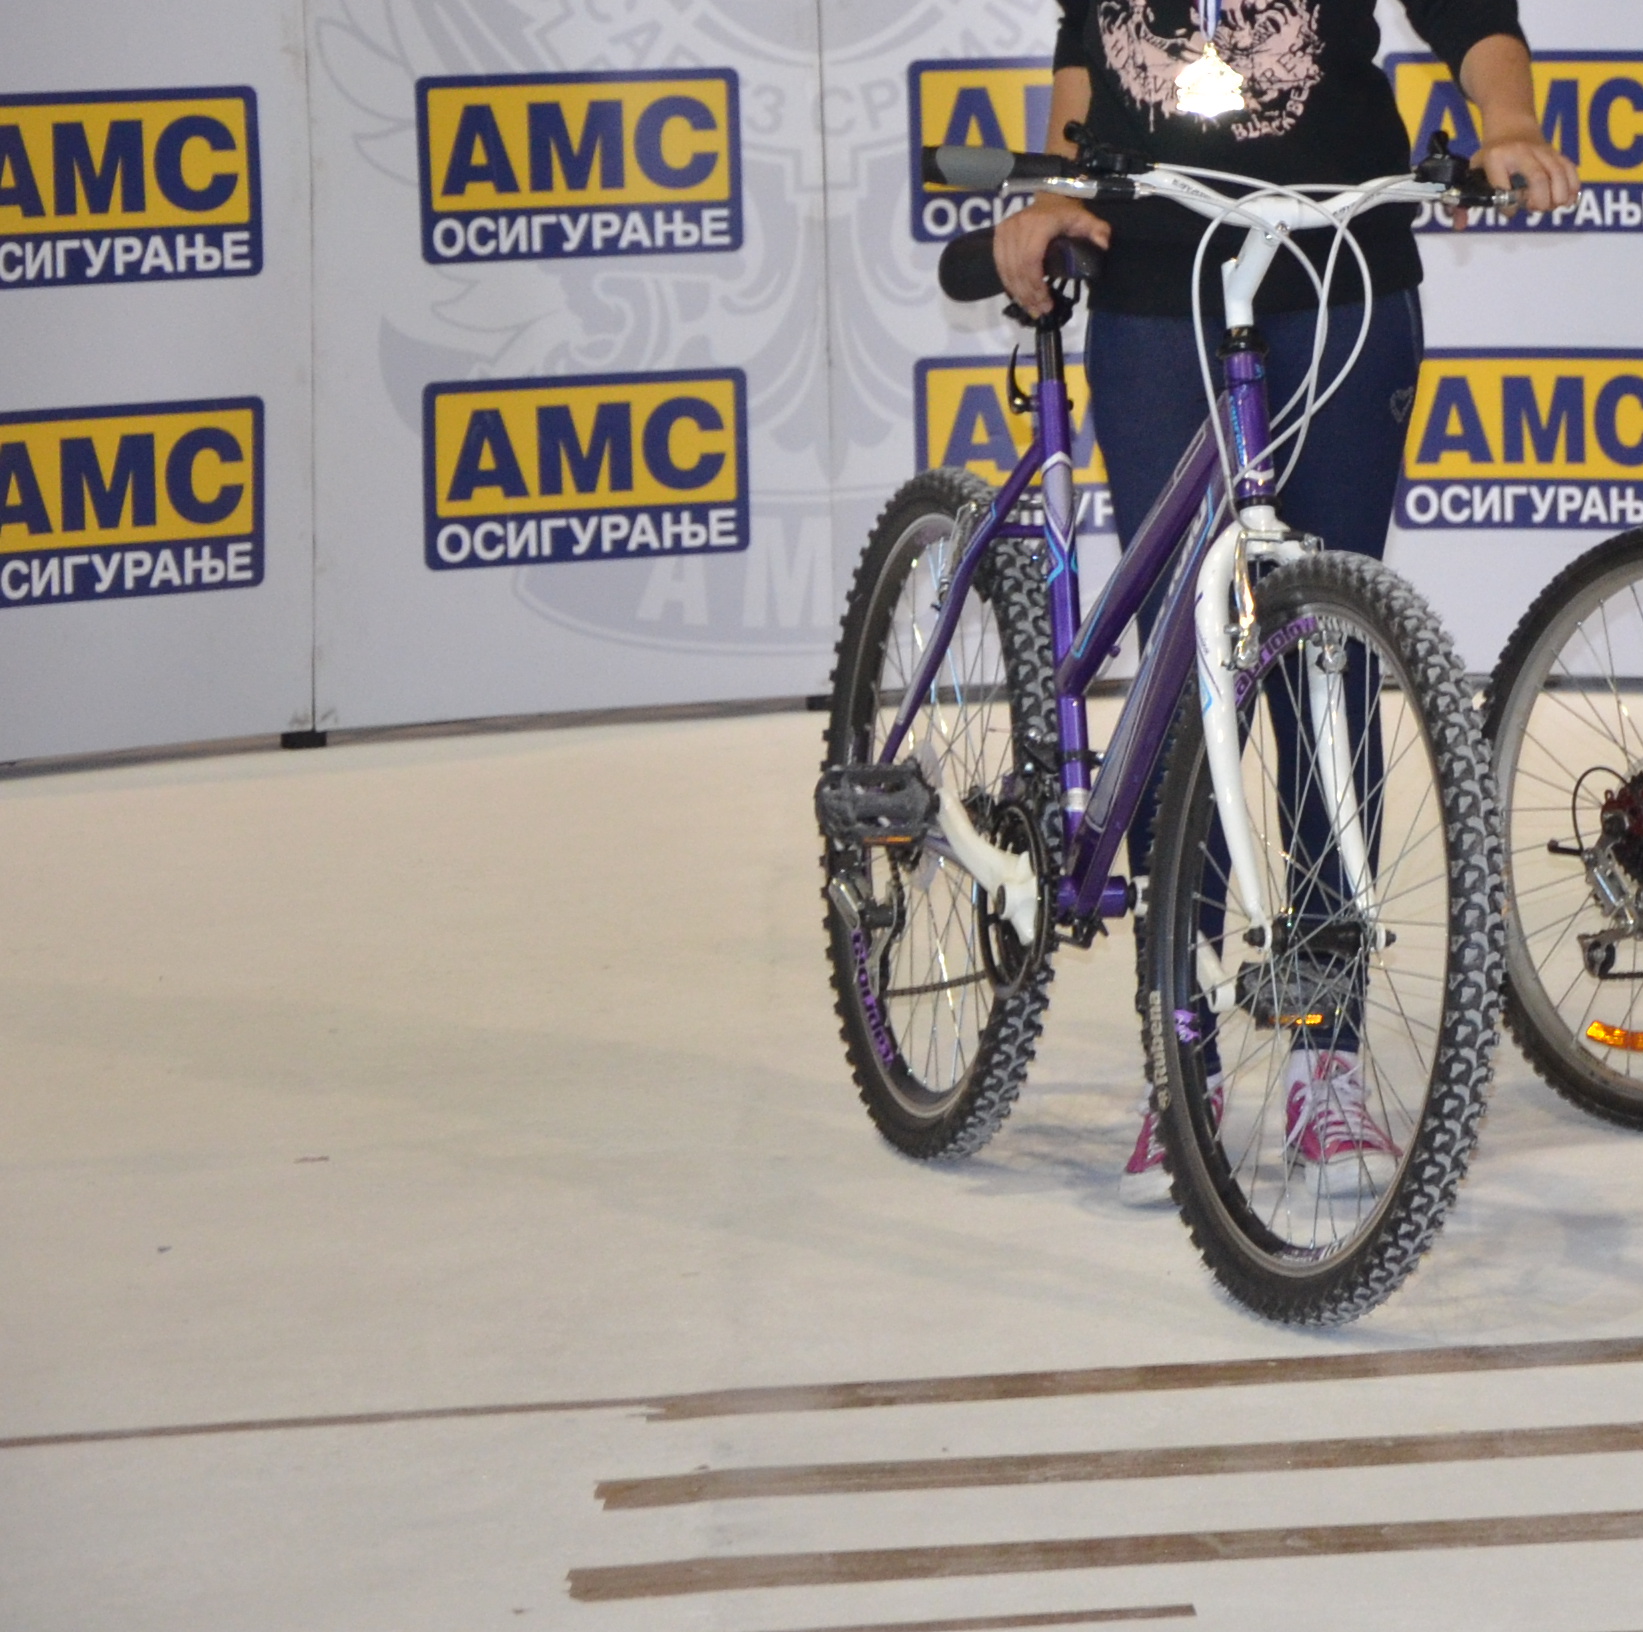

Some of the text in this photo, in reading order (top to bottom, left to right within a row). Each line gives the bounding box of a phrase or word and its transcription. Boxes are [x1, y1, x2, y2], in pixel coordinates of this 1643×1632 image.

[440, 95, 720, 196] АМС
[0, 231, 251, 282] СИГУРАЊЕ
[433, 210, 731, 257] ОСИГУРАЊЕ
[446, 395, 727, 502] АМС
[437, 510, 738, 563] ОСИГУРАЊЕ
[0, 541, 253, 600] СИГУРАЊЕ
[636, 517, 835, 628] АМ
